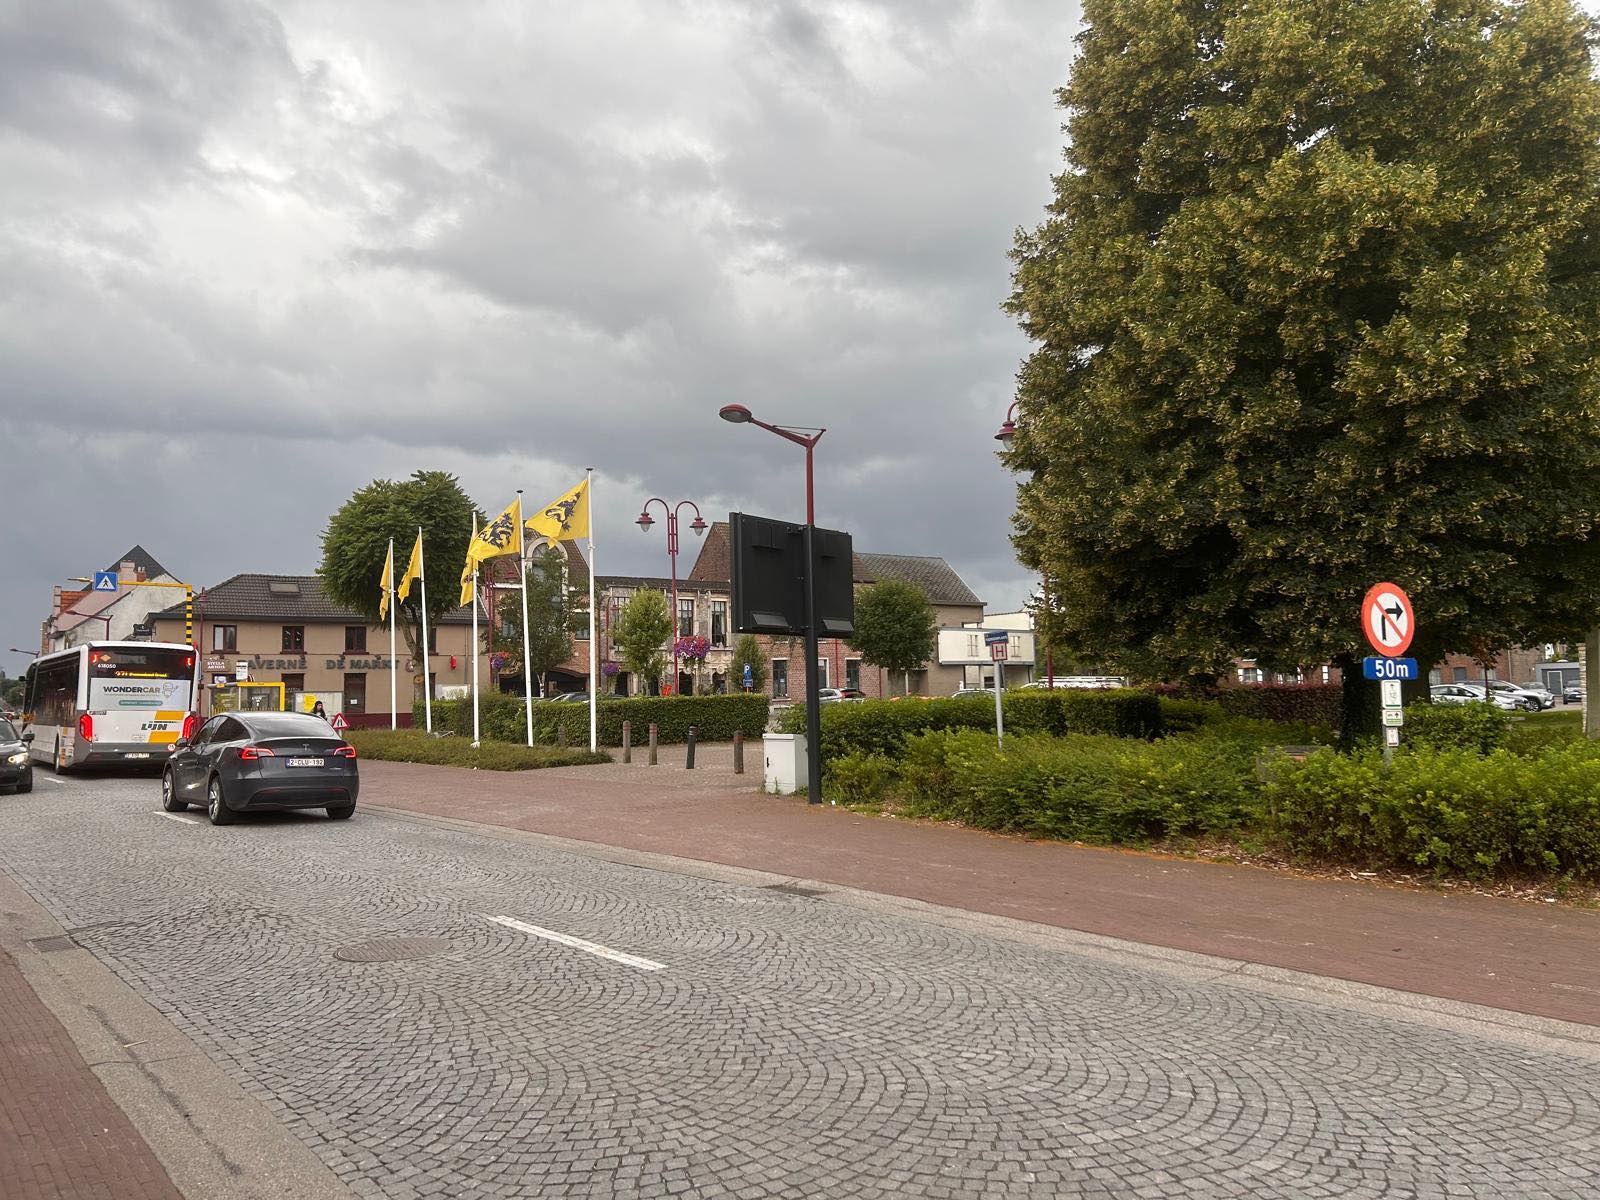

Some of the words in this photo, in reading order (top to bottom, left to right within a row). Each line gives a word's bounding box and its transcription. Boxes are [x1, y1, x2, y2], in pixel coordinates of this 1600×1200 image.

[995, 645, 1004, 657] H
[247, 659, 308, 670] AVERNE
[326, 659, 346, 670] DE
[1375, 659, 1409, 678] 50m
